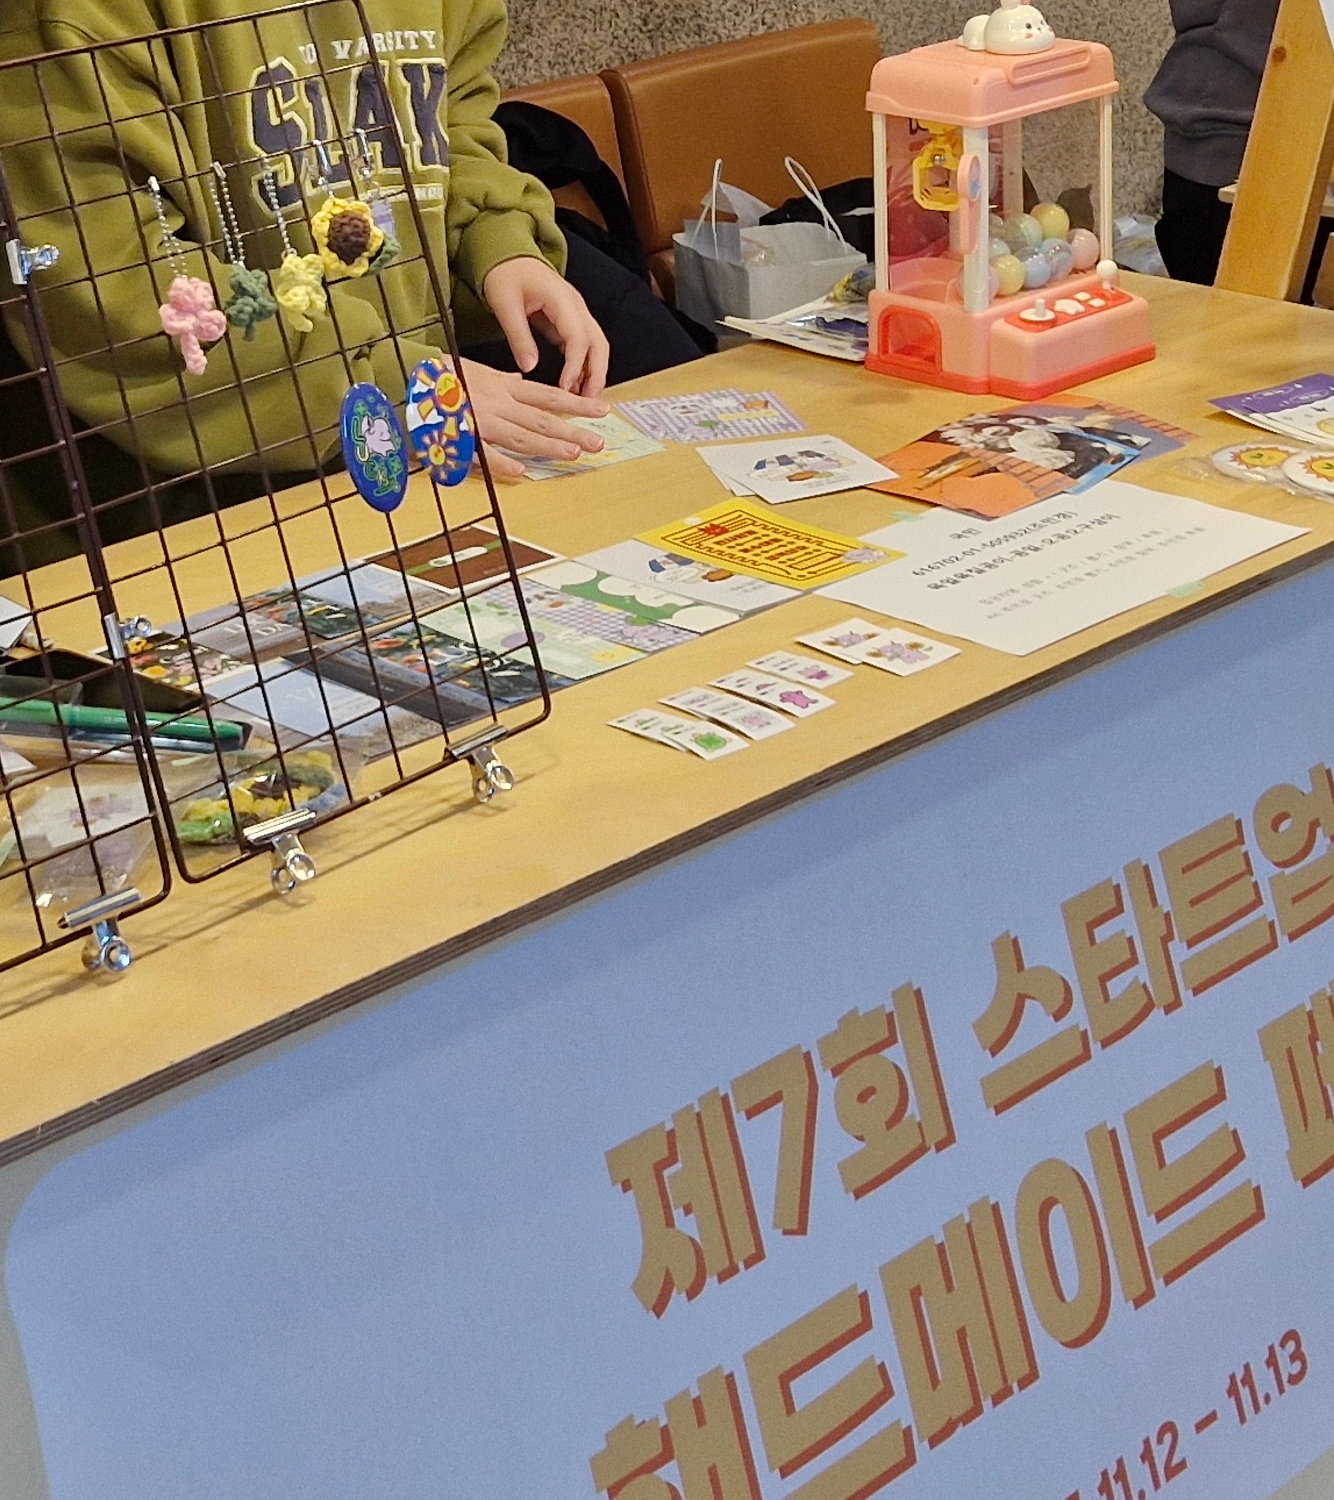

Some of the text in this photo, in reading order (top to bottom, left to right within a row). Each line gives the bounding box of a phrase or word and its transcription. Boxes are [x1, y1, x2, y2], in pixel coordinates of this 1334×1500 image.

[331, 30, 437, 60] VARSITY
[604, 982, 956, 1318] 제7회
[1064, 1328, 1308, 1500] 11.12 11.13
